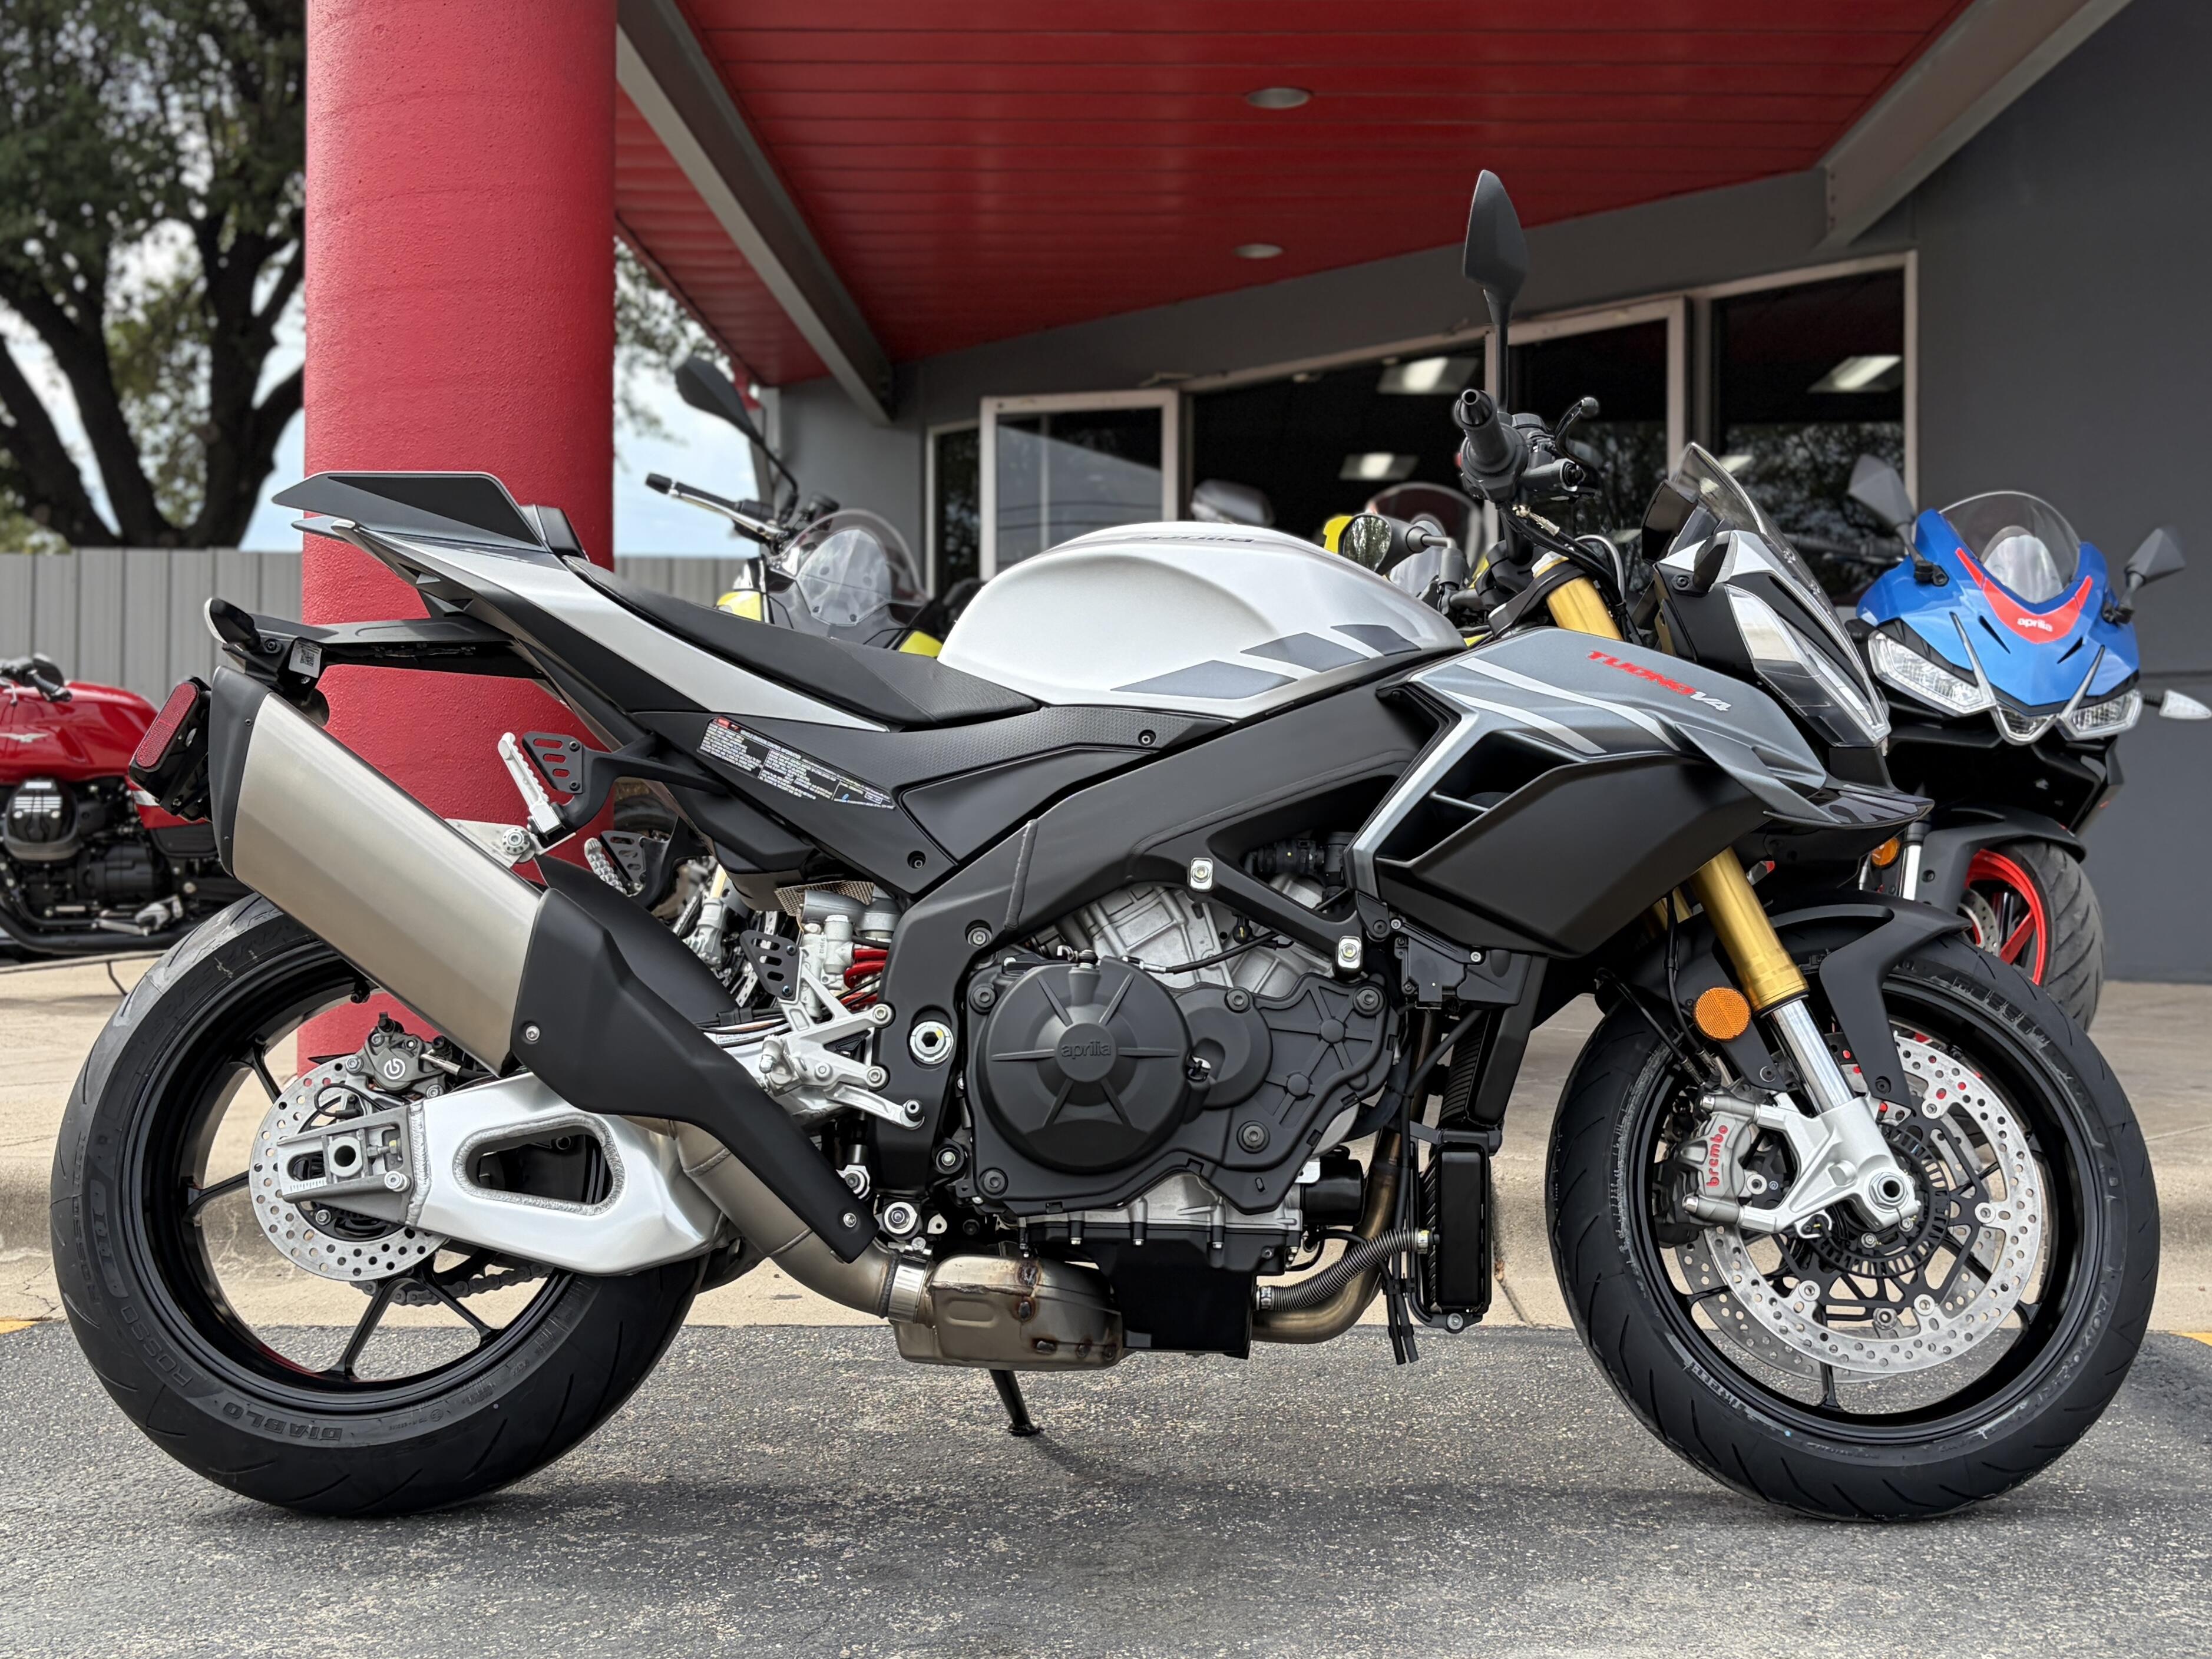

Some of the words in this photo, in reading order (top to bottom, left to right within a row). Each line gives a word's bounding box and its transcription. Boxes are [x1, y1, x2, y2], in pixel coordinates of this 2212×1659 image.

[2016, 617, 2053, 632] aprilia
[1588, 650, 1697, 696] TUONO
[1689, 691, 1732, 712] V4
[1060, 1040, 1112, 1059] aprilia
[1706, 1125, 1728, 1187] brembo
[120, 1305, 194, 1389] ROSSO
[223, 1401, 344, 1442] DIABLO
